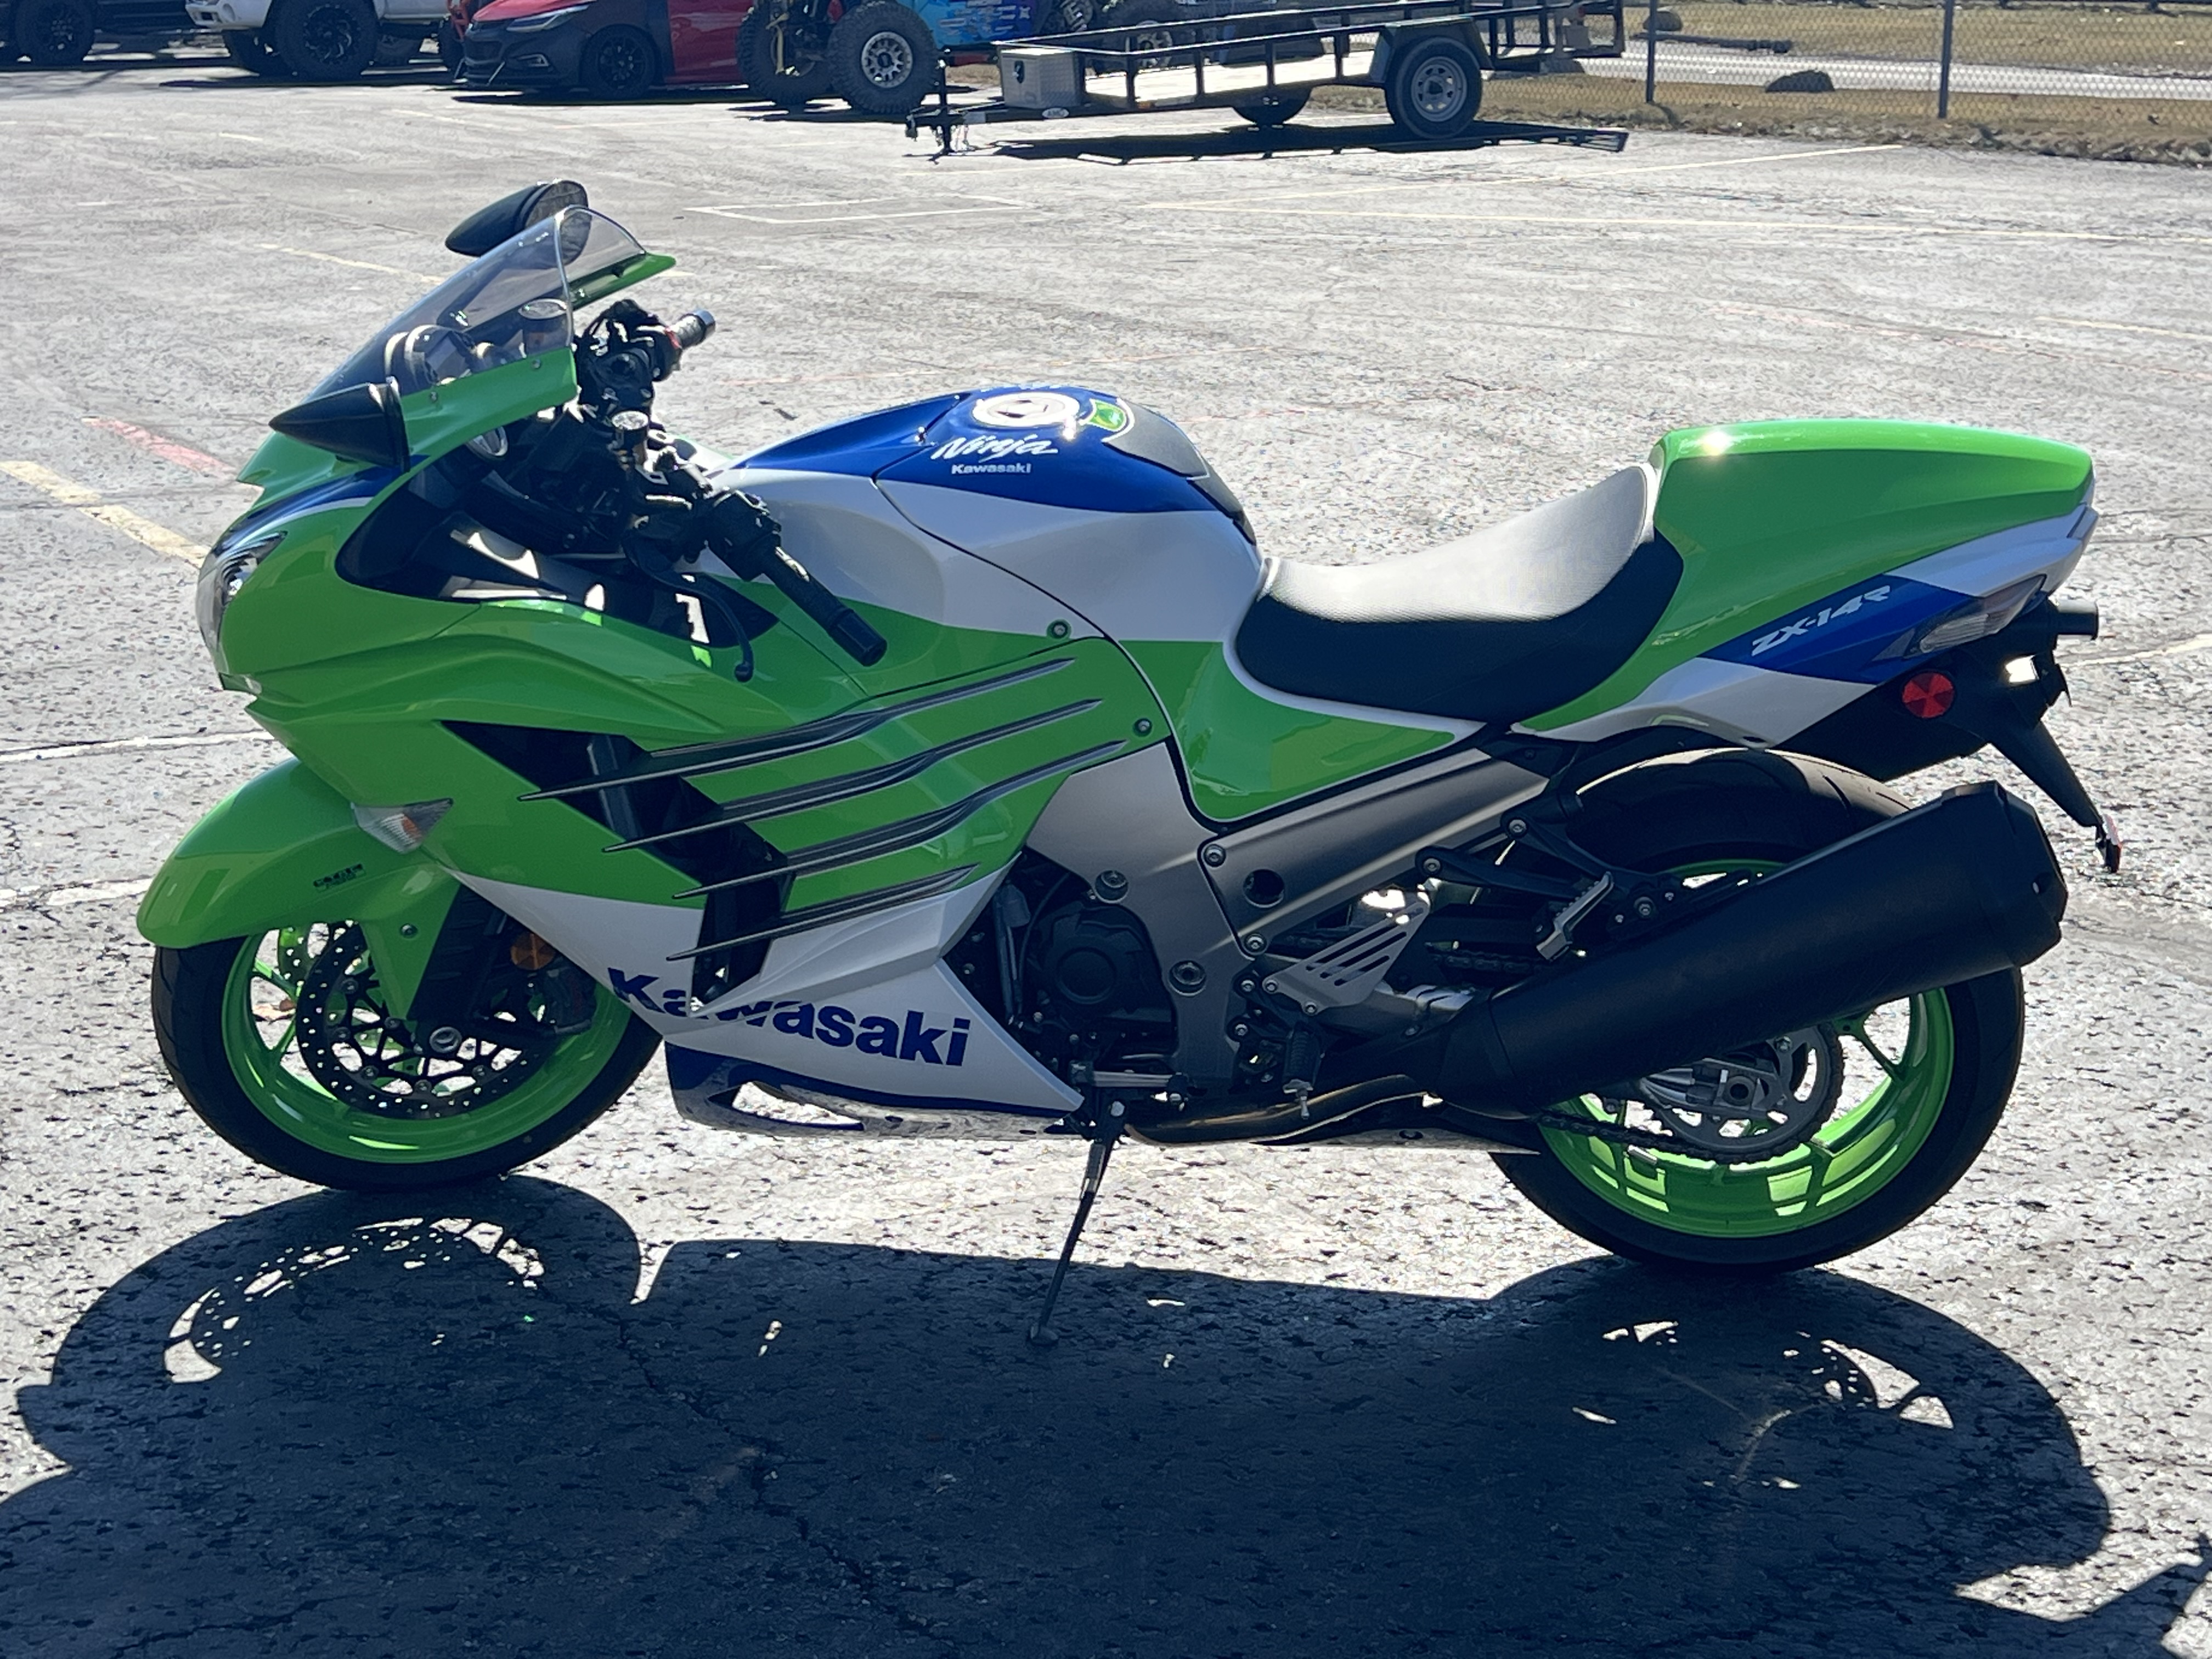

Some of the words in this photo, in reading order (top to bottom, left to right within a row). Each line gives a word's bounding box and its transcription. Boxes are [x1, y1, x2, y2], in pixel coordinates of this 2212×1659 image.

[930, 434, 1058, 463] Ninja
[951, 463, 1031, 474] Kawasaki
[1751, 585, 1891, 657] ZX-14R
